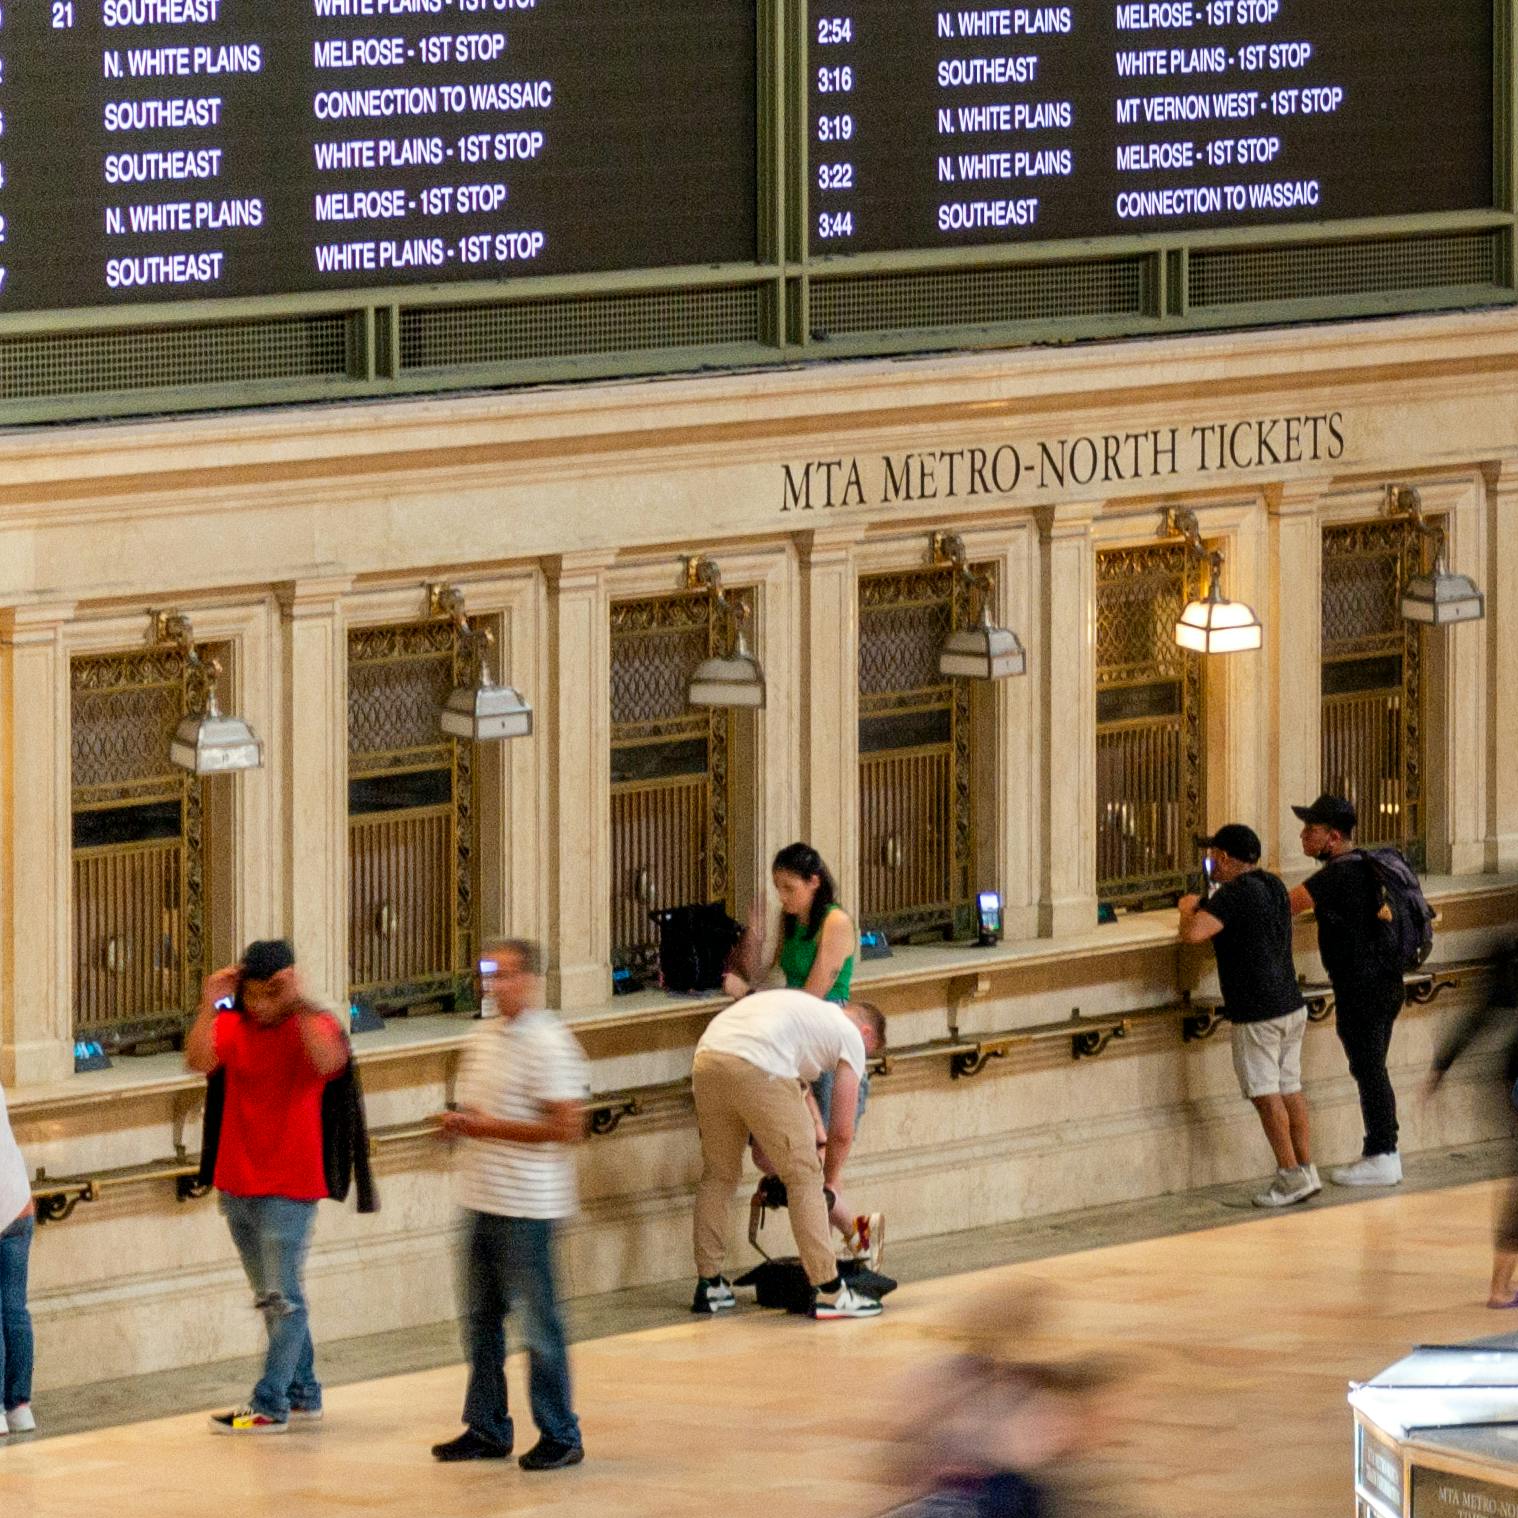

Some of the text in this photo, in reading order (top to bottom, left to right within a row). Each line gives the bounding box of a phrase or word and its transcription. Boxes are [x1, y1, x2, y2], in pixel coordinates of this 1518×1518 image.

[51, 1, 73, 29] 21
[103, 0, 220, 27] SOUTHEAST
[817, 17, 852, 44] 2:54
[937, 6, 1072, 38] N. WHITE PLAINS
[1116, 0, 1279, 30] MELROSE 1ST STOP
[103, 44, 262, 79] N. WHITE PLAINS
[314, 33, 505, 68] MELROSE 1ST STOP
[1115, 42, 1311, 77] WHITE PLAINS 1ST STOP
[817, 65, 852, 93] 3:16
[937, 55, 1038, 87] SOUTHEAST
[104, 97, 222, 132] SOUTHEAST
[313, 80, 552, 120] CONNECTION TO WASSAIC
[1116, 86, 1343, 124] MT VERNON WEST 1ST STOP
[818, 114, 853, 141] 3:19
[938, 101, 1072, 134] N. WHITE PLAINS
[104, 148, 222, 184] SOUTHEAST
[314, 131, 544, 170] WHITE PLAINS 1ST STOP
[938, 149, 1072, 182] N. WHITE PLAINS
[1116, 137, 1280, 171] MELROSE 1ST STOP
[818, 163, 853, 190] 3:22
[315, 183, 506, 221] MELROSE 1ST STOP
[938, 198, 1038, 231] SOUTHEAST
[1116, 180, 1319, 218] CONNECTION TO WASSAIC
[105, 198, 263, 235] N. WHITE PLAINS
[818, 211, 853, 238] 3:44
[315, 231, 544, 272] WHITE PLAINS 1ST STOP
[106, 252, 224, 288] SOUTHEAST
[780, 411, 1345, 512] MTA METRO-NORTH TICKETS
